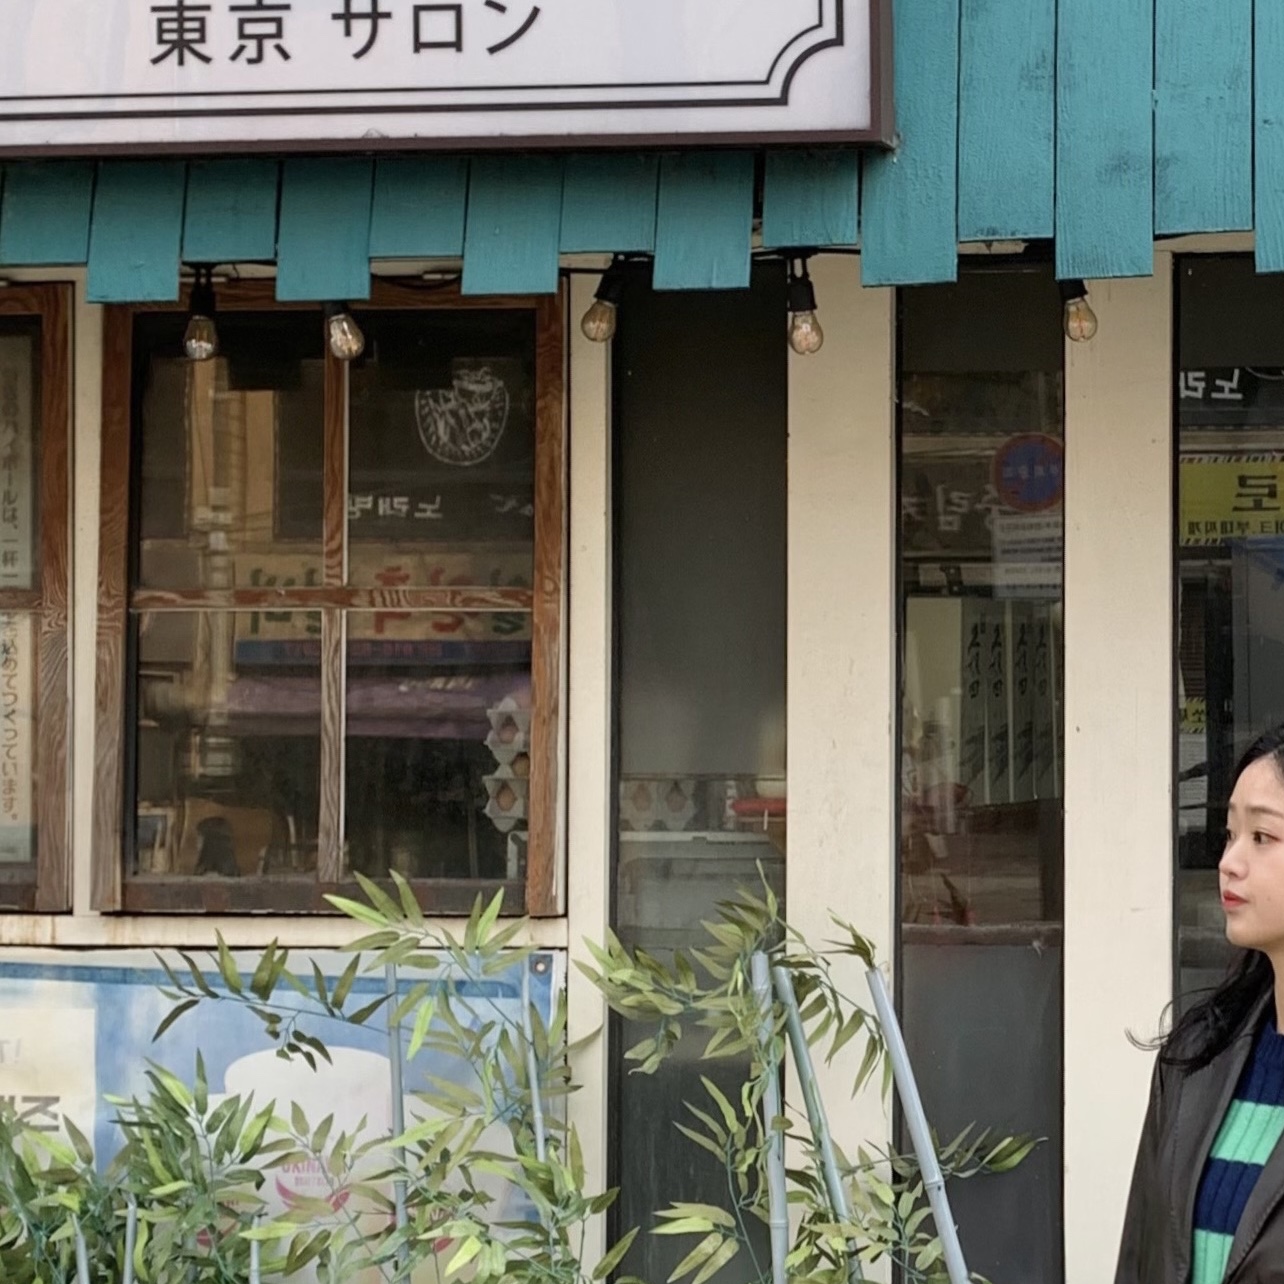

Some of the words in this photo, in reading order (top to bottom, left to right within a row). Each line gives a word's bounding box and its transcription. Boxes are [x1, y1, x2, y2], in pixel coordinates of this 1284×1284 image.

[150, 0, 292, 66] 東京
[331, 0, 540, 60] サロン
